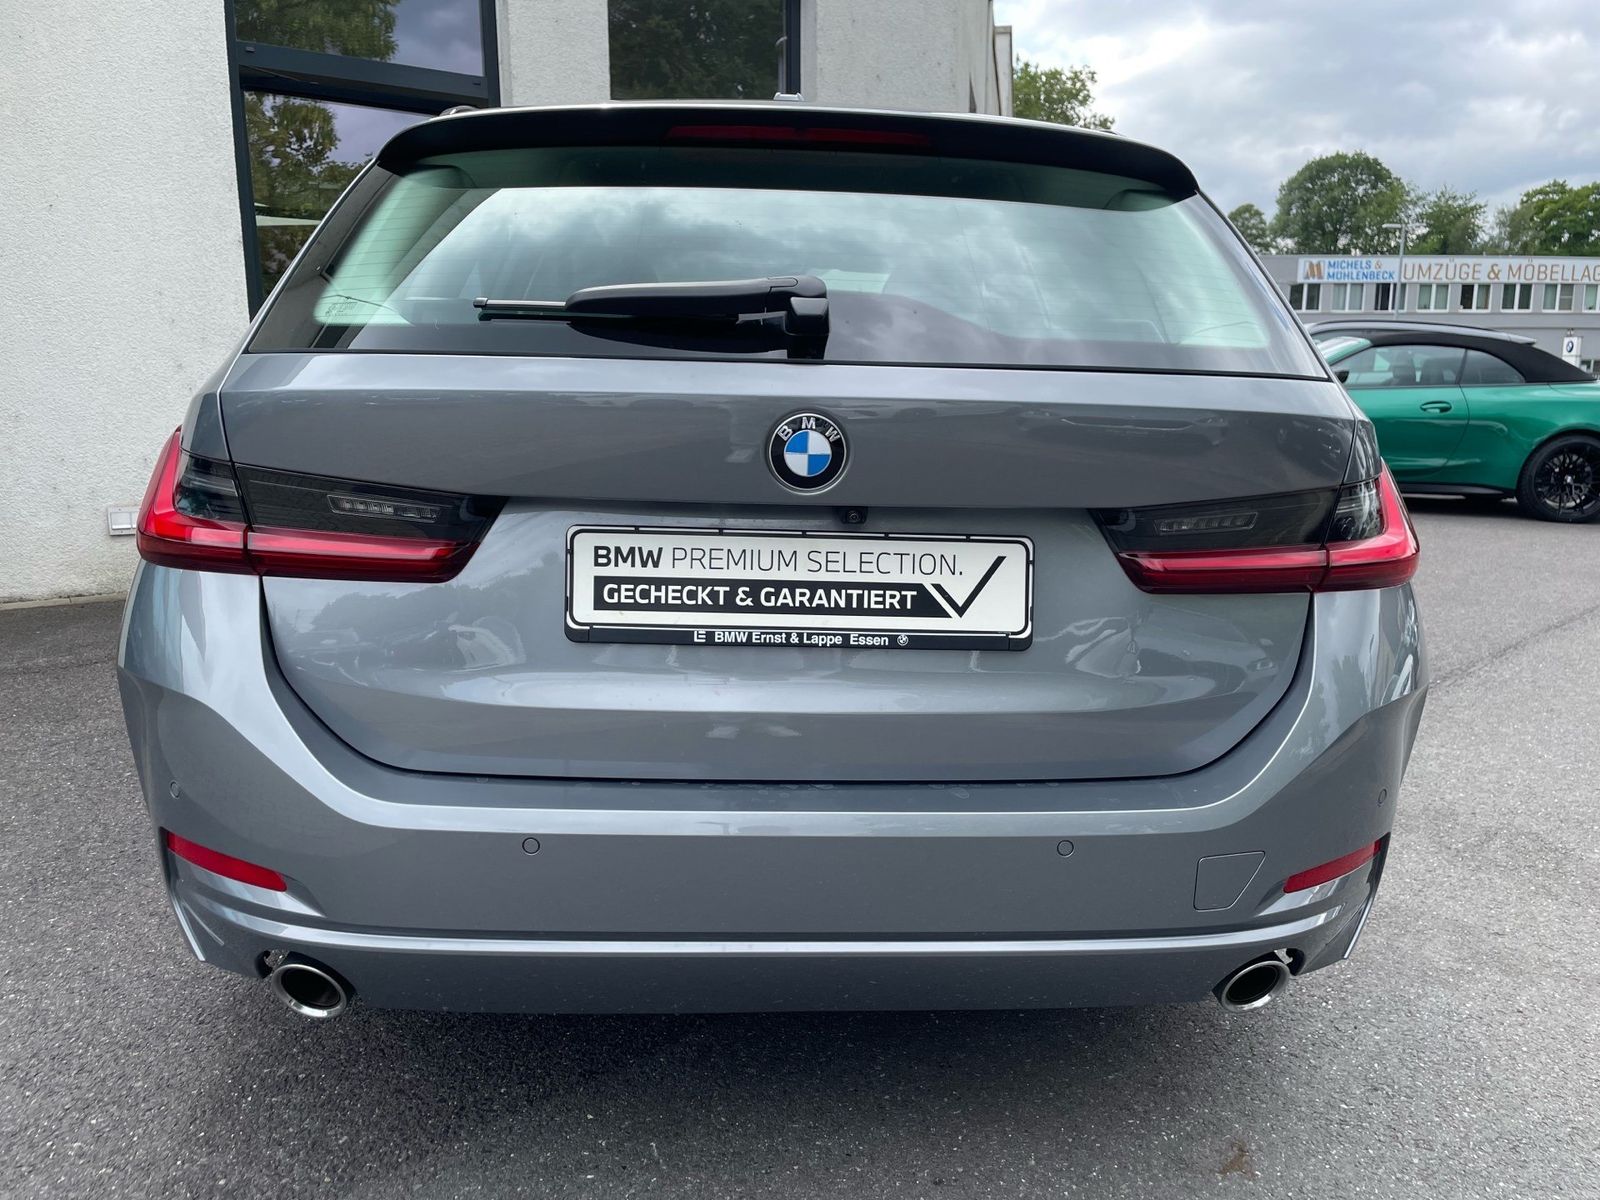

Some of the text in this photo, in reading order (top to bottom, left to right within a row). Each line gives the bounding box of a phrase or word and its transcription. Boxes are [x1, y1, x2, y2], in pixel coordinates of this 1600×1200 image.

[1328, 260, 1383, 270] MICHELS &
[1403, 258, 1482, 281] UMZÜGE
[1487, 263, 1502, 281] &
[777, 416, 841, 443] BMW
[593, 545, 963, 576] BMW PREMIUM SELECTION.
[603, 583, 917, 609] GECHECKT & GARANTIERT
[714, 631, 749, 643] BMW
[752, 631, 787, 644] Ernst
[790, 632, 799, 644] &
[803, 632, 843, 645] Lappe
[850, 633, 889, 646] Essen
